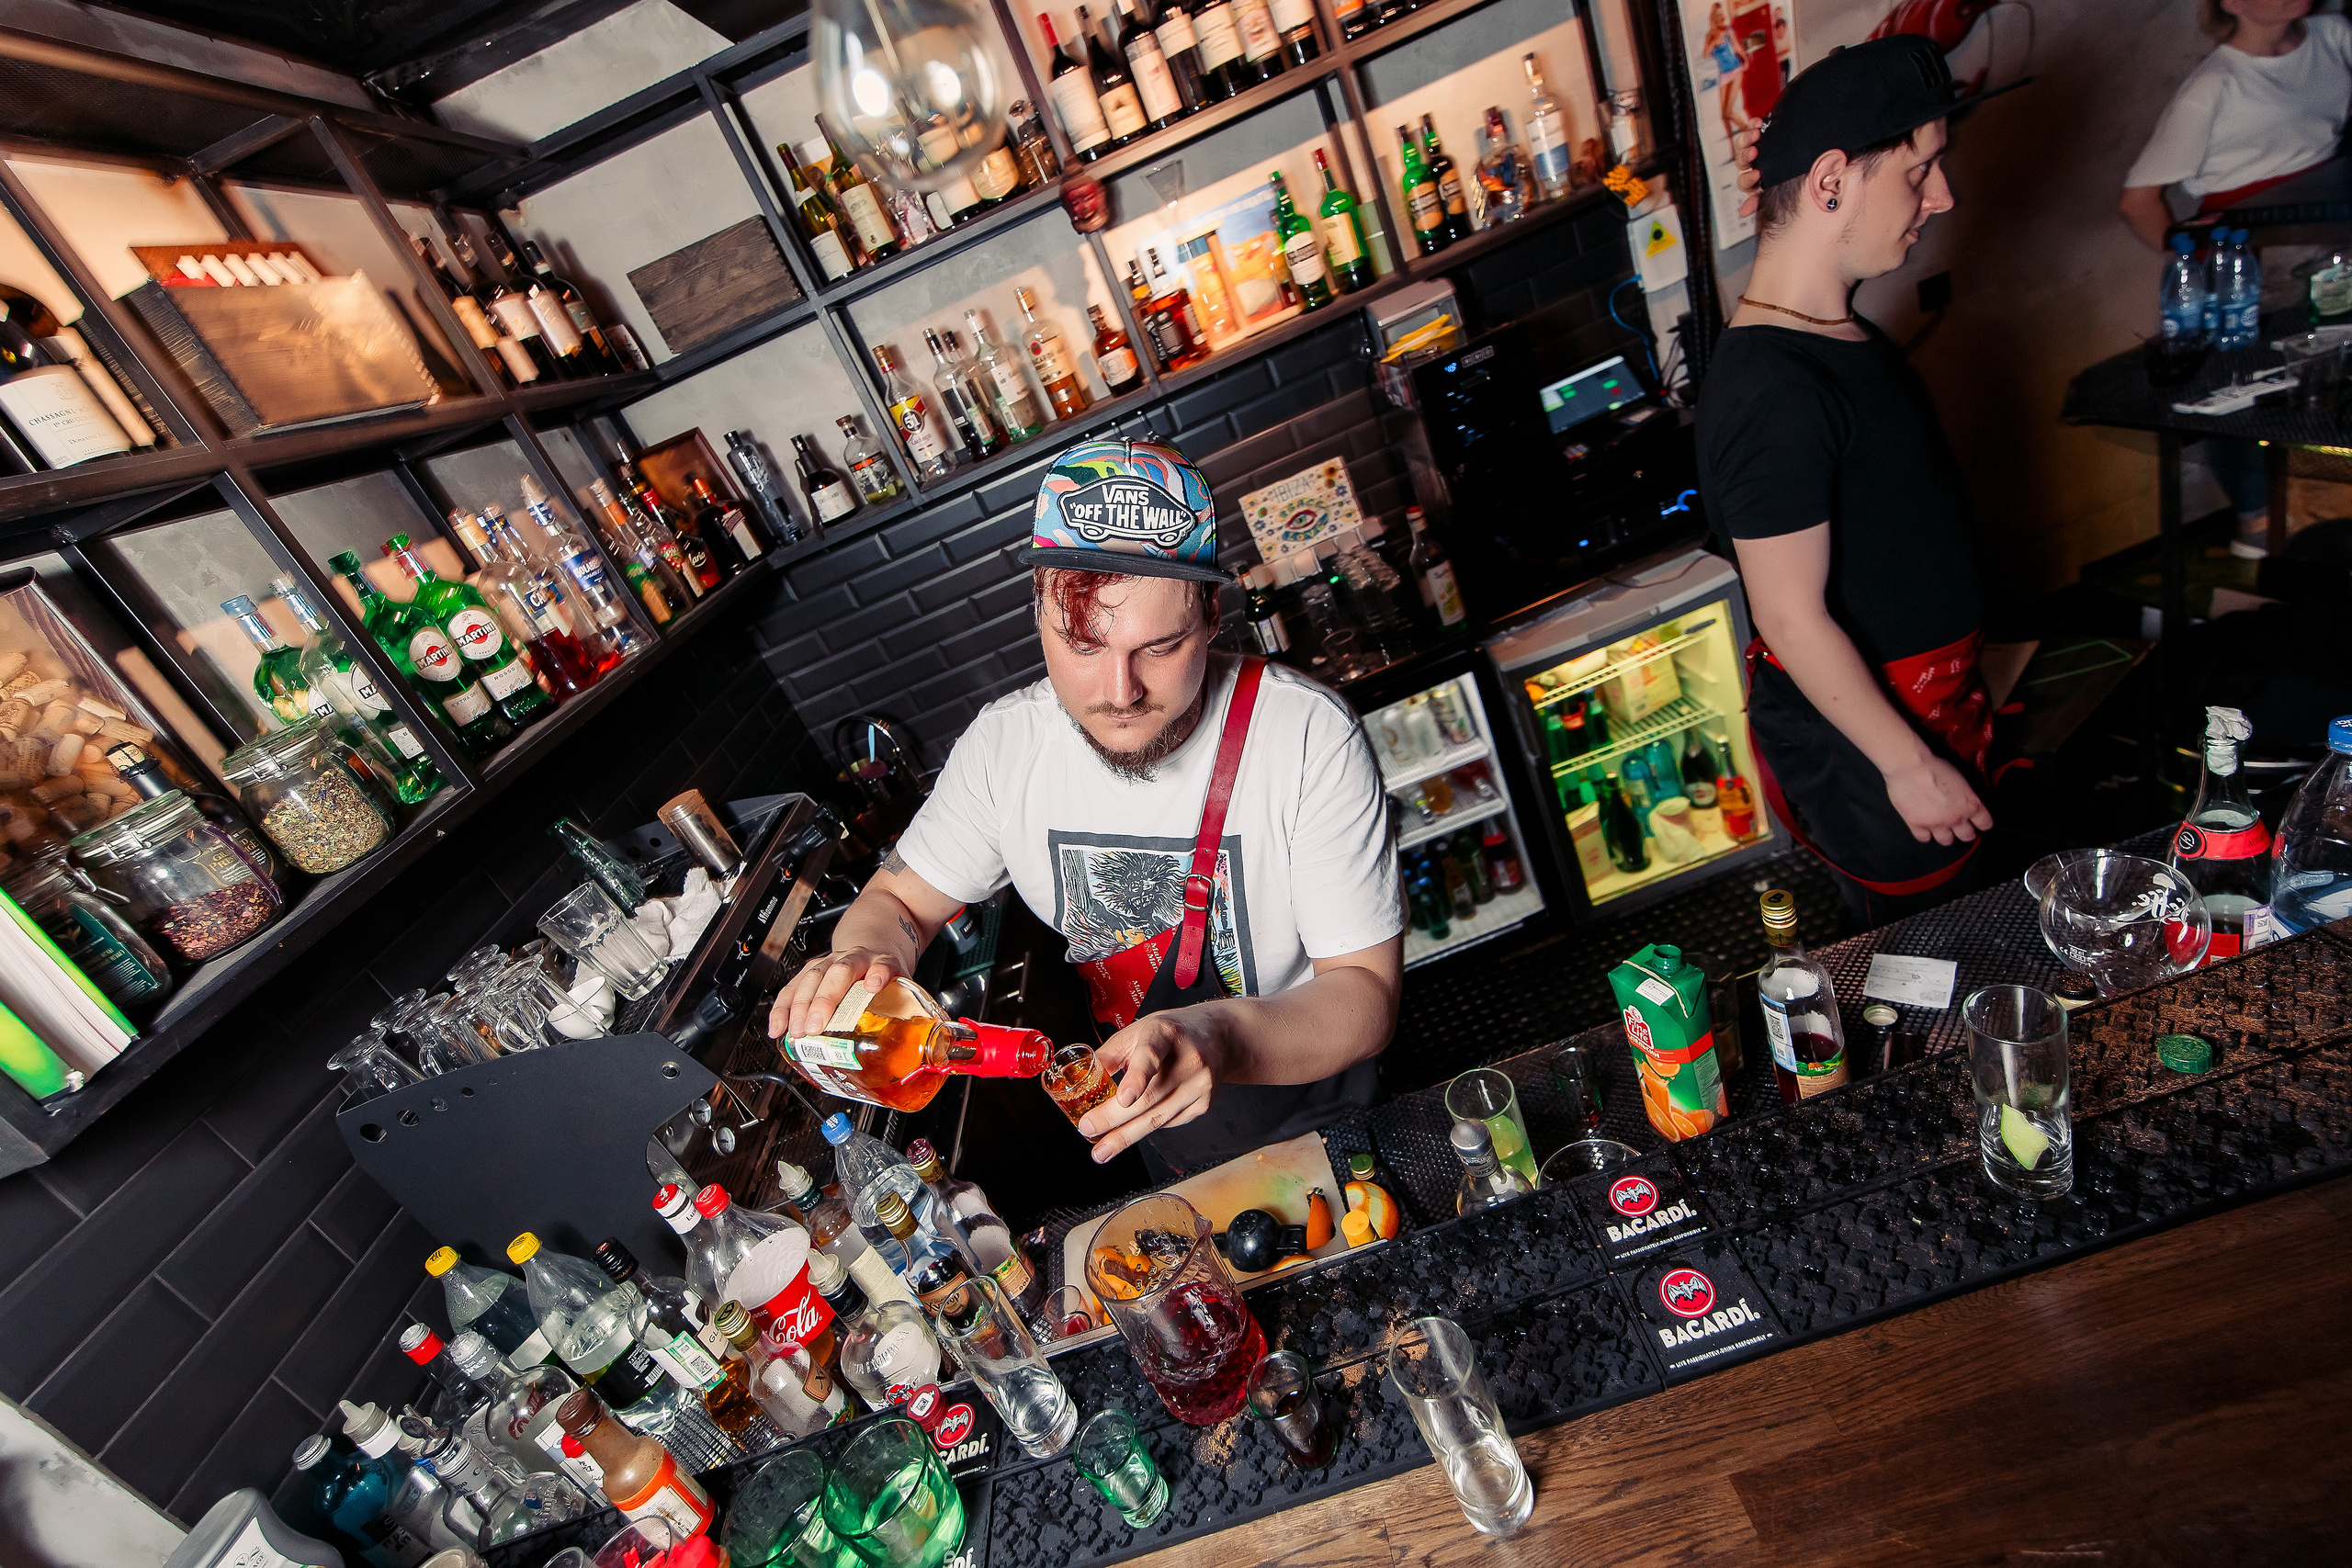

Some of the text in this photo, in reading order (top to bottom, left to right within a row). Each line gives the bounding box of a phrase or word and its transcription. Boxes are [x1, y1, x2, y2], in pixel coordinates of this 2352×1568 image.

[1102, 484, 1149, 505] VANS
[1105, 504, 1139, 529] THE
[456, 622, 496, 647] MARTINI
[416, 645, 453, 670] MARTINI
[493, 667, 515, 681] ROSSO
[1627, 1015, 1648, 1036] Fine
[1632, 1024, 1649, 1043] Life
[769, 1289, 819, 1343] Cola
[464, 1360, 476, 1369] Ron
[938, 1433, 989, 1466] CARDÍ
